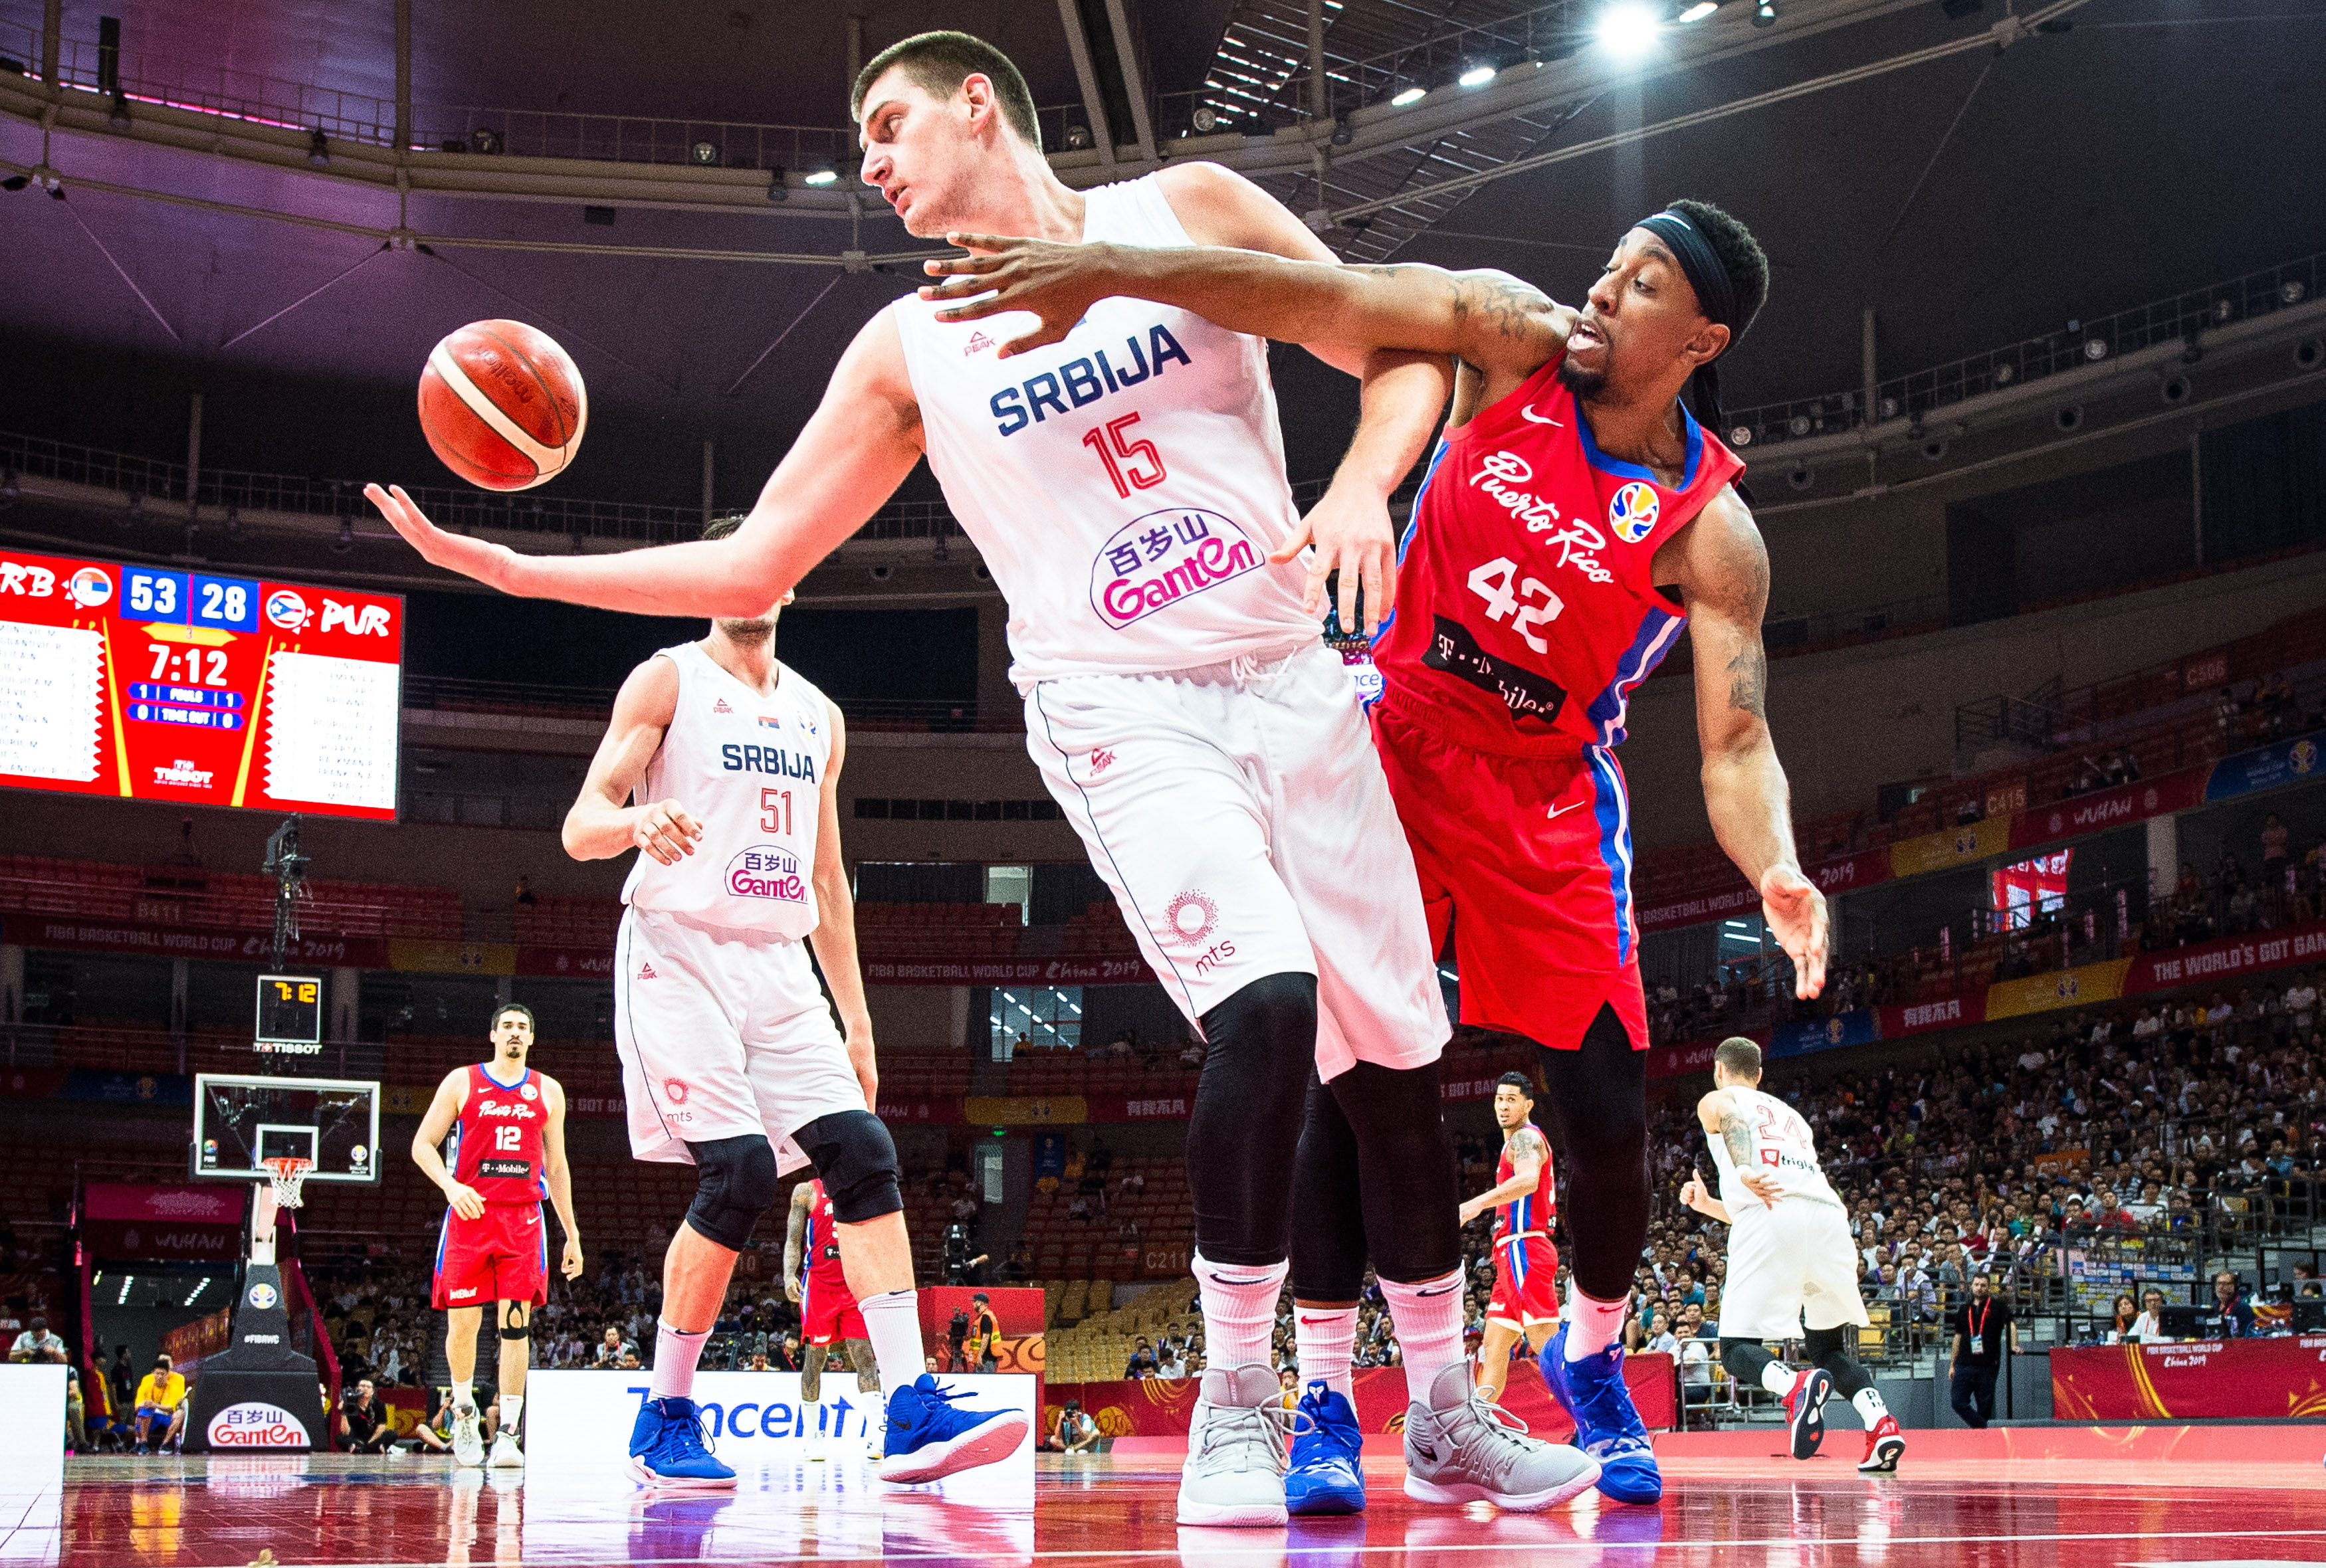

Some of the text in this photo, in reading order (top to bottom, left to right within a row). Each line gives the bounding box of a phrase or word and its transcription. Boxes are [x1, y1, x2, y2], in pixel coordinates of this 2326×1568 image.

[964, 337, 996, 357] PEAK
[990, 324, 1192, 437] SRBIJA
[1083, 410, 1167, 499] 15
[1469, 450, 1614, 585] Puerto Rico
[1105, 514, 1210, 577] 百岁山
[0, 561, 391, 637] RB 53 28 PUR
[1467, 555, 1565, 655] 42
[148, 643, 229, 687] 7:12
[139, 684, 148, 699] 1
[225, 692, 234, 708] 1
[137, 704, 149, 720] 0
[222, 712, 234, 729] 0
[154, 767, 213, 784] TISSOT
[721, 743, 817, 785] SRBIJA
[760, 787, 792, 836] 51
[1987, 789, 2026, 815] C415
[2073, 795, 2133, 827] WUHAN
[744, 852, 797, 875] 百岁山
[1820, 862, 1856, 889] 2019
[138, 902, 182, 922] B411
[1642, 898, 1708, 925] BASKETBALL
[1708, 894, 1745, 910] WORLD
[1746, 888, 1763, 904] CU
[78, 926, 159, 949] BASKETBALL
[163, 934, 208, 951] WORLD
[211, 937, 237, 953] CUP
[242, 937, 299, 957] Chna
[304, 941, 346, 960] 2019
[579, 957, 613, 972] WUH
[867, 960, 1141, 980] FIBA BASKETBALL WORLD CUP China 2019
[1194, 938, 1236, 976] mts
[2153, 931, 2326, 983] THE WORLD'S GOT GAM
[274, 981, 317, 1004] 7:12
[272, 1043, 323, 1055] TISSOT
[607, 1098, 626, 1114] GA
[667, 1110, 693, 1124] mts
[495, 1126, 522, 1152] 12
[1756, 1104, 1807, 1151] 24
[1781, 1155, 1816, 1175] trigla
[155, 1232, 226, 1250] WUHAN
[2188, 1354, 2207, 1367] 2019
[226, 1409, 284, 1426] 百岁山
[627, 1387, 855, 1438] Tncent
